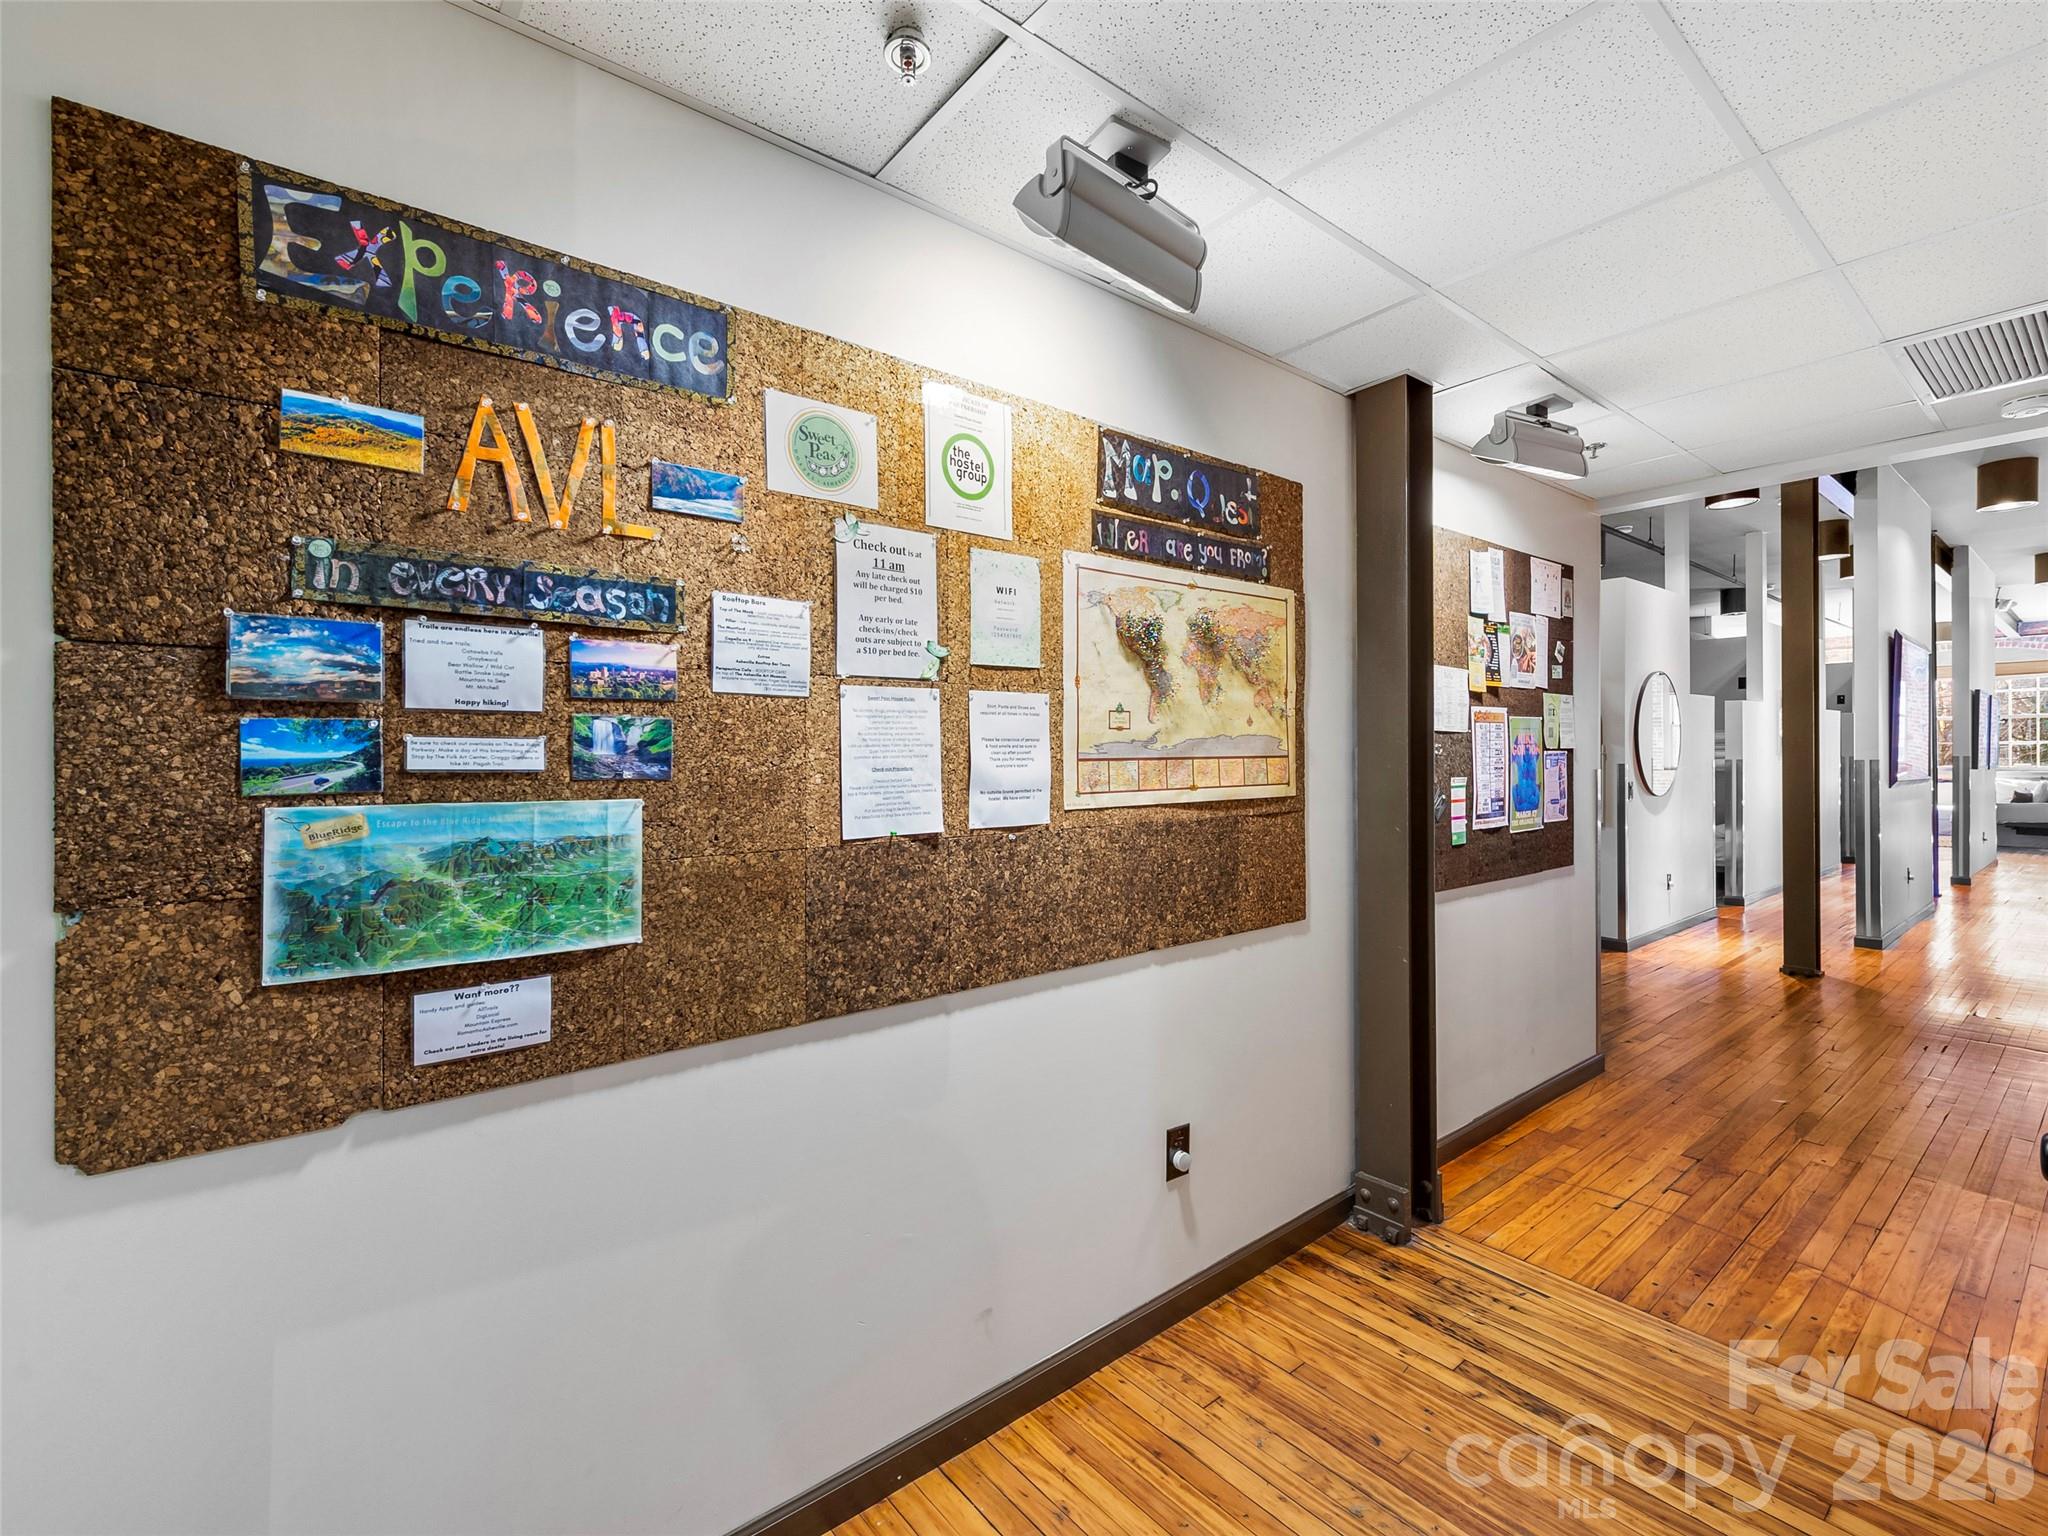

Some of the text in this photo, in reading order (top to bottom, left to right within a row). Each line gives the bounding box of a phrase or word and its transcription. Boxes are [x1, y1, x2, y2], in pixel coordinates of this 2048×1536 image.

[799, 425, 835, 446] Sweet
[809, 442, 836, 461] Peas
[952, 445, 970, 460] the
[448, 395, 662, 540] AVL
[950, 455, 984, 473] hostel
[956, 469, 987, 486] group
[853, 539, 887, 553] Check
[890, 546, 907, 556] out
[1199, 543, 1223, 565] you
[308, 539, 359, 591] in
[873, 558, 905, 572] 11 am
[856, 570, 870, 580] Any
[872, 572, 885, 581] late
[887, 574, 907, 583] check
[853, 581, 923, 596] will be charged $10
[996, 586, 1016, 596] WIFI
[722, 595, 749, 605] Rooftop
[875, 594, 903, 604] per bed.
[859, 614, 873, 623] Any
[875, 616, 893, 625] early
[905, 618, 918, 626] late
[859, 625, 918, 637] check-ins/check
[887, 637, 912, 647] subject
[863, 646, 877, 655] $10
[879, 648, 891, 657] per
[893, 648, 906, 657] bed
[907, 649, 920, 657] fee.
[455, 699, 508, 707] Happy hiking!
[376, 819, 407, 828] Escape
[423, 817, 438, 825] the
[308, 825, 363, 841] BlueRidge
[454, 984, 520, 1001] Want more??
[439, 1005, 453, 1013] Apps
[424, 1047, 443, 1056] Check
[467, 1039, 489, 1048] binders
[508, 1034, 522, 1042] living
